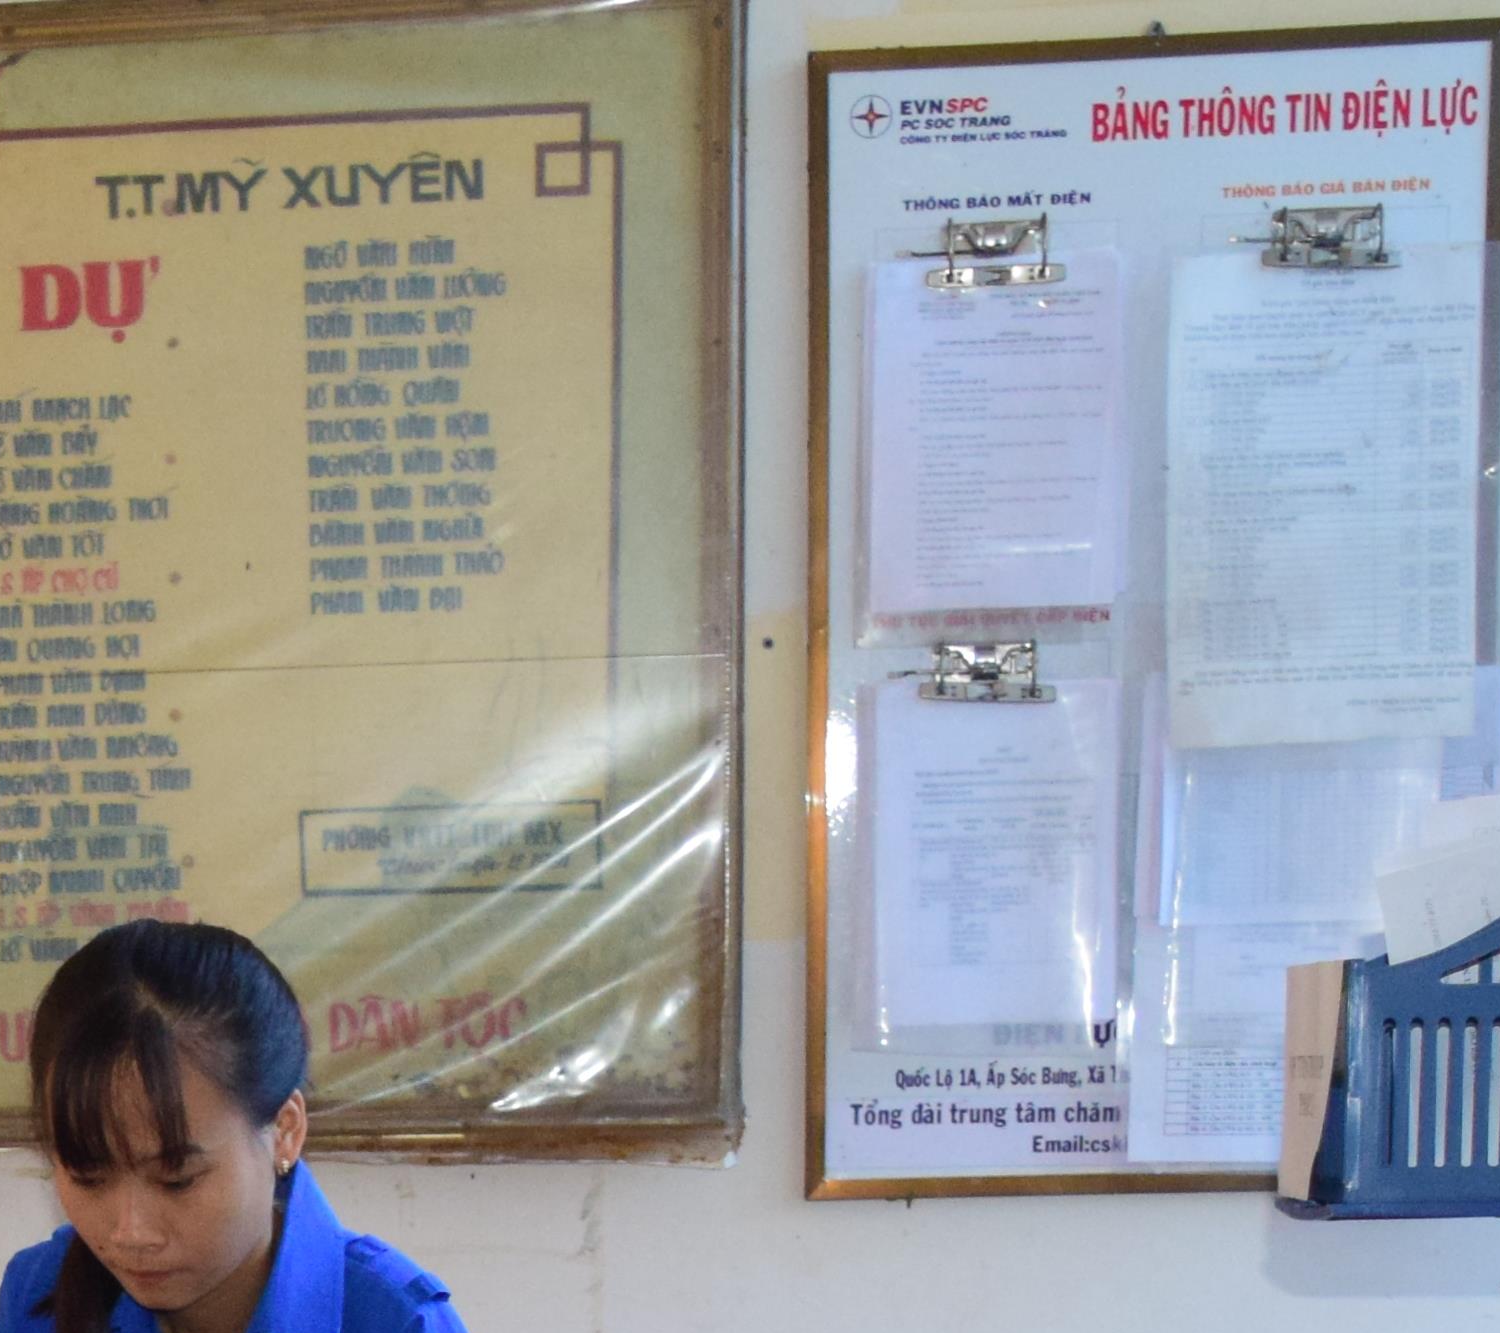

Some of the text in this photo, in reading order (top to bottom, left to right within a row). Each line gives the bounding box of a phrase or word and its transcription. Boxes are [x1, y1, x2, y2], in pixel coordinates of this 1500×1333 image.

[900, 97, 988, 116] EVNSPC
[1092, 79, 1478, 142] BẢNG THÔNG TIN ĐIỆN LỰC
[900, 119, 920, 131] PC
[282, 150, 485, 208] XUYÊN
[1222, 182, 1276, 199] THÔNG
[1281, 181, 1314, 196] BÁO
[1319, 179, 1347, 195] GIÁ
[1391, 177, 1431, 193] ĐIỆN
[903, 190, 1091, 211] THÔNG BÁO MẤT ĐIỆN
[19, 256, 164, 344] DỰ
[895, 1066, 930, 1089] Quốc
[936, 1068, 953, 1091] Lộ
[960, 1069, 981, 1089] 1A,
[986, 1060, 1005, 1089] Ấp
[1010, 1066, 1036, 1086] Sóc
[1087, 1065, 1105, 1084] Xã
[850, 1099, 903, 1129] Tổng
[912, 1102, 942, 1125] đài
[950, 1103, 1007, 1128] trung
[1015, 1101, 1056, 1124] tâm
